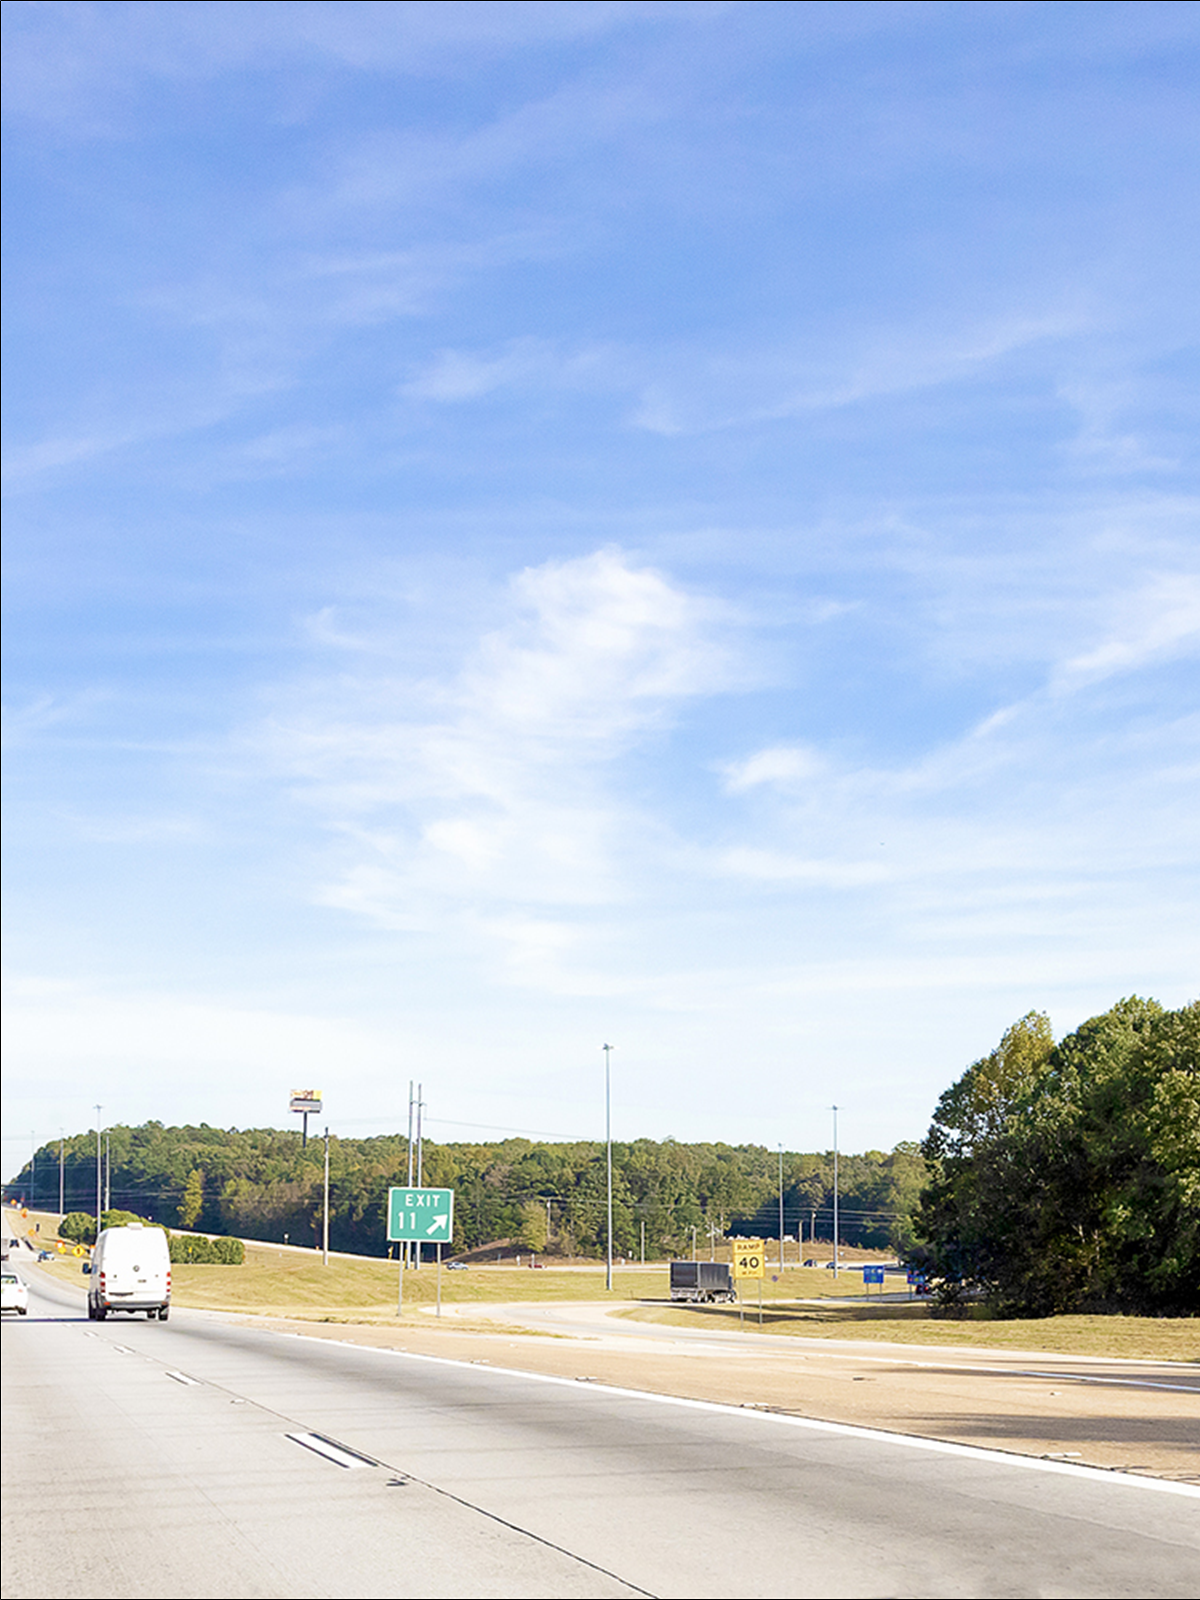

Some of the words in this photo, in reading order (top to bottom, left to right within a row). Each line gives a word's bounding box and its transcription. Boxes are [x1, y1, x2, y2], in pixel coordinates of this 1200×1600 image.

[405, 1194, 440, 1207] EXIT
[398, 1211, 416, 1230] 11
[737, 1243, 760, 1251] RAMP
[739, 1256, 760, 1269] 40
